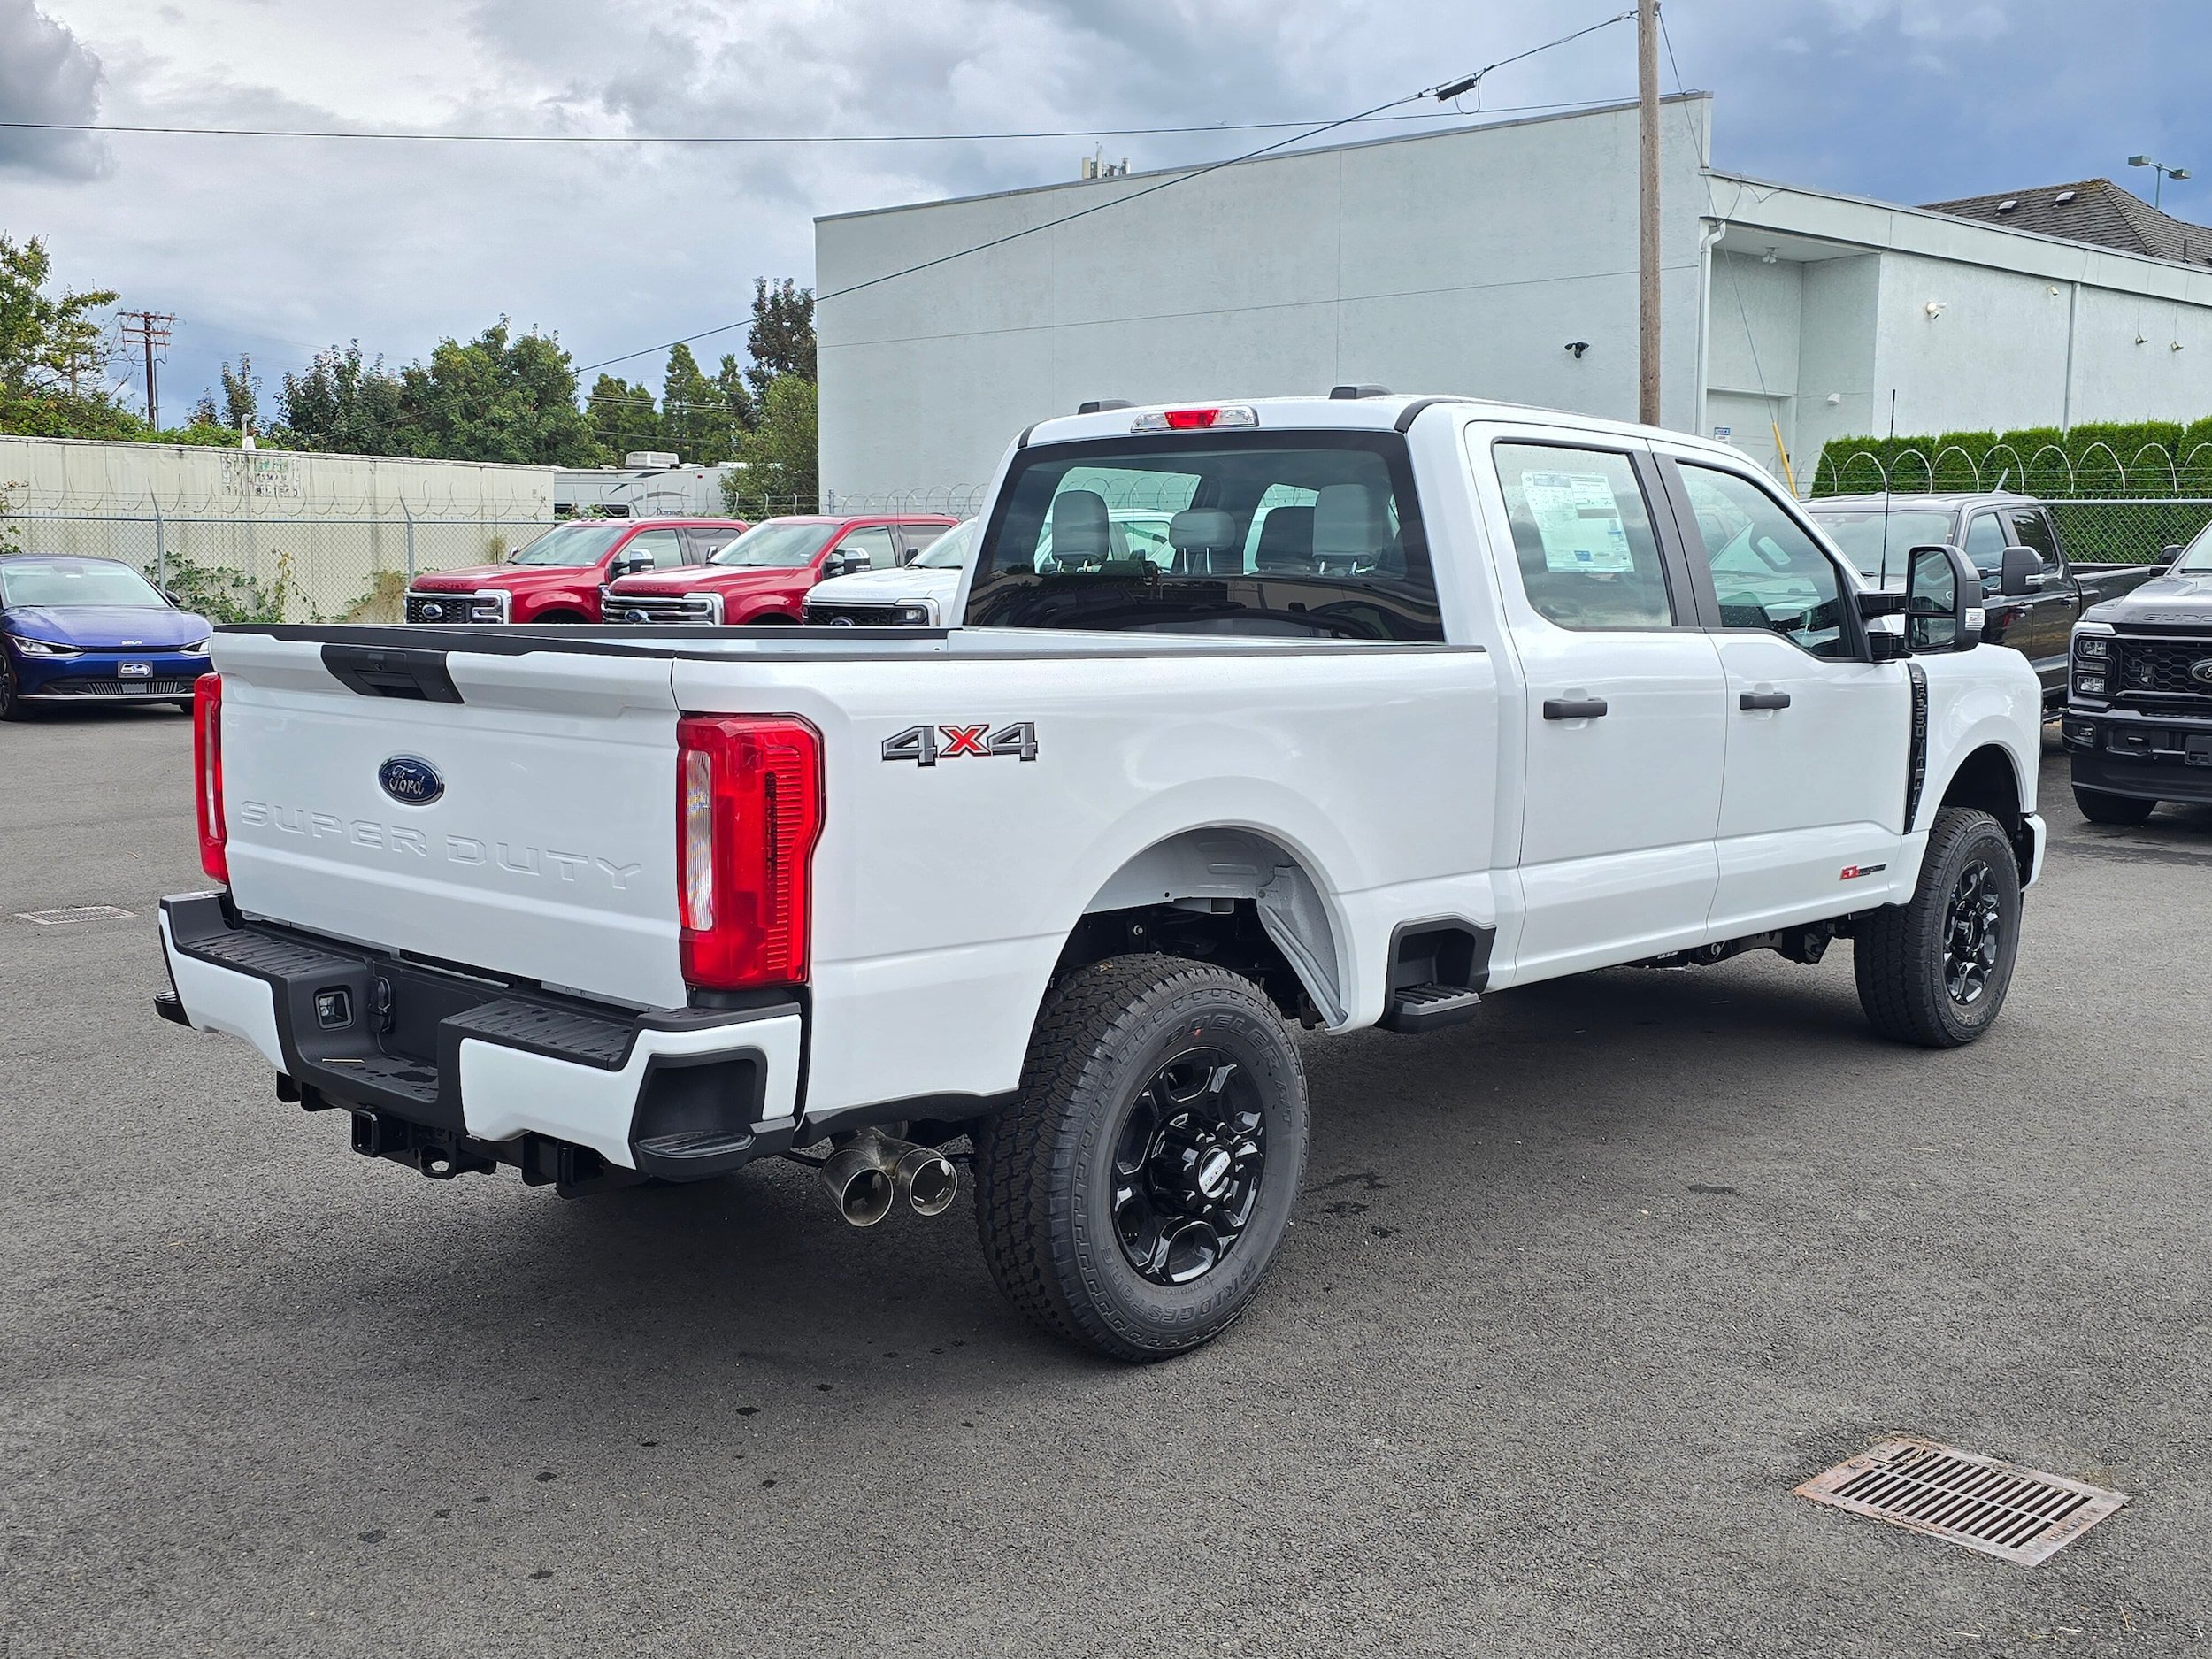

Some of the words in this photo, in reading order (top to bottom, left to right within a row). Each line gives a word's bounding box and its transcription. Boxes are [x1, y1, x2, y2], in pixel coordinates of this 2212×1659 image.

[388, 764, 426, 795] Ford
[240, 799, 428, 857] SUPER
[445, 833, 642, 890] DUTY
[1162, 1013, 1282, 1072] DUELER
[1100, 1244, 1256, 1325] BRIDGESTONE
